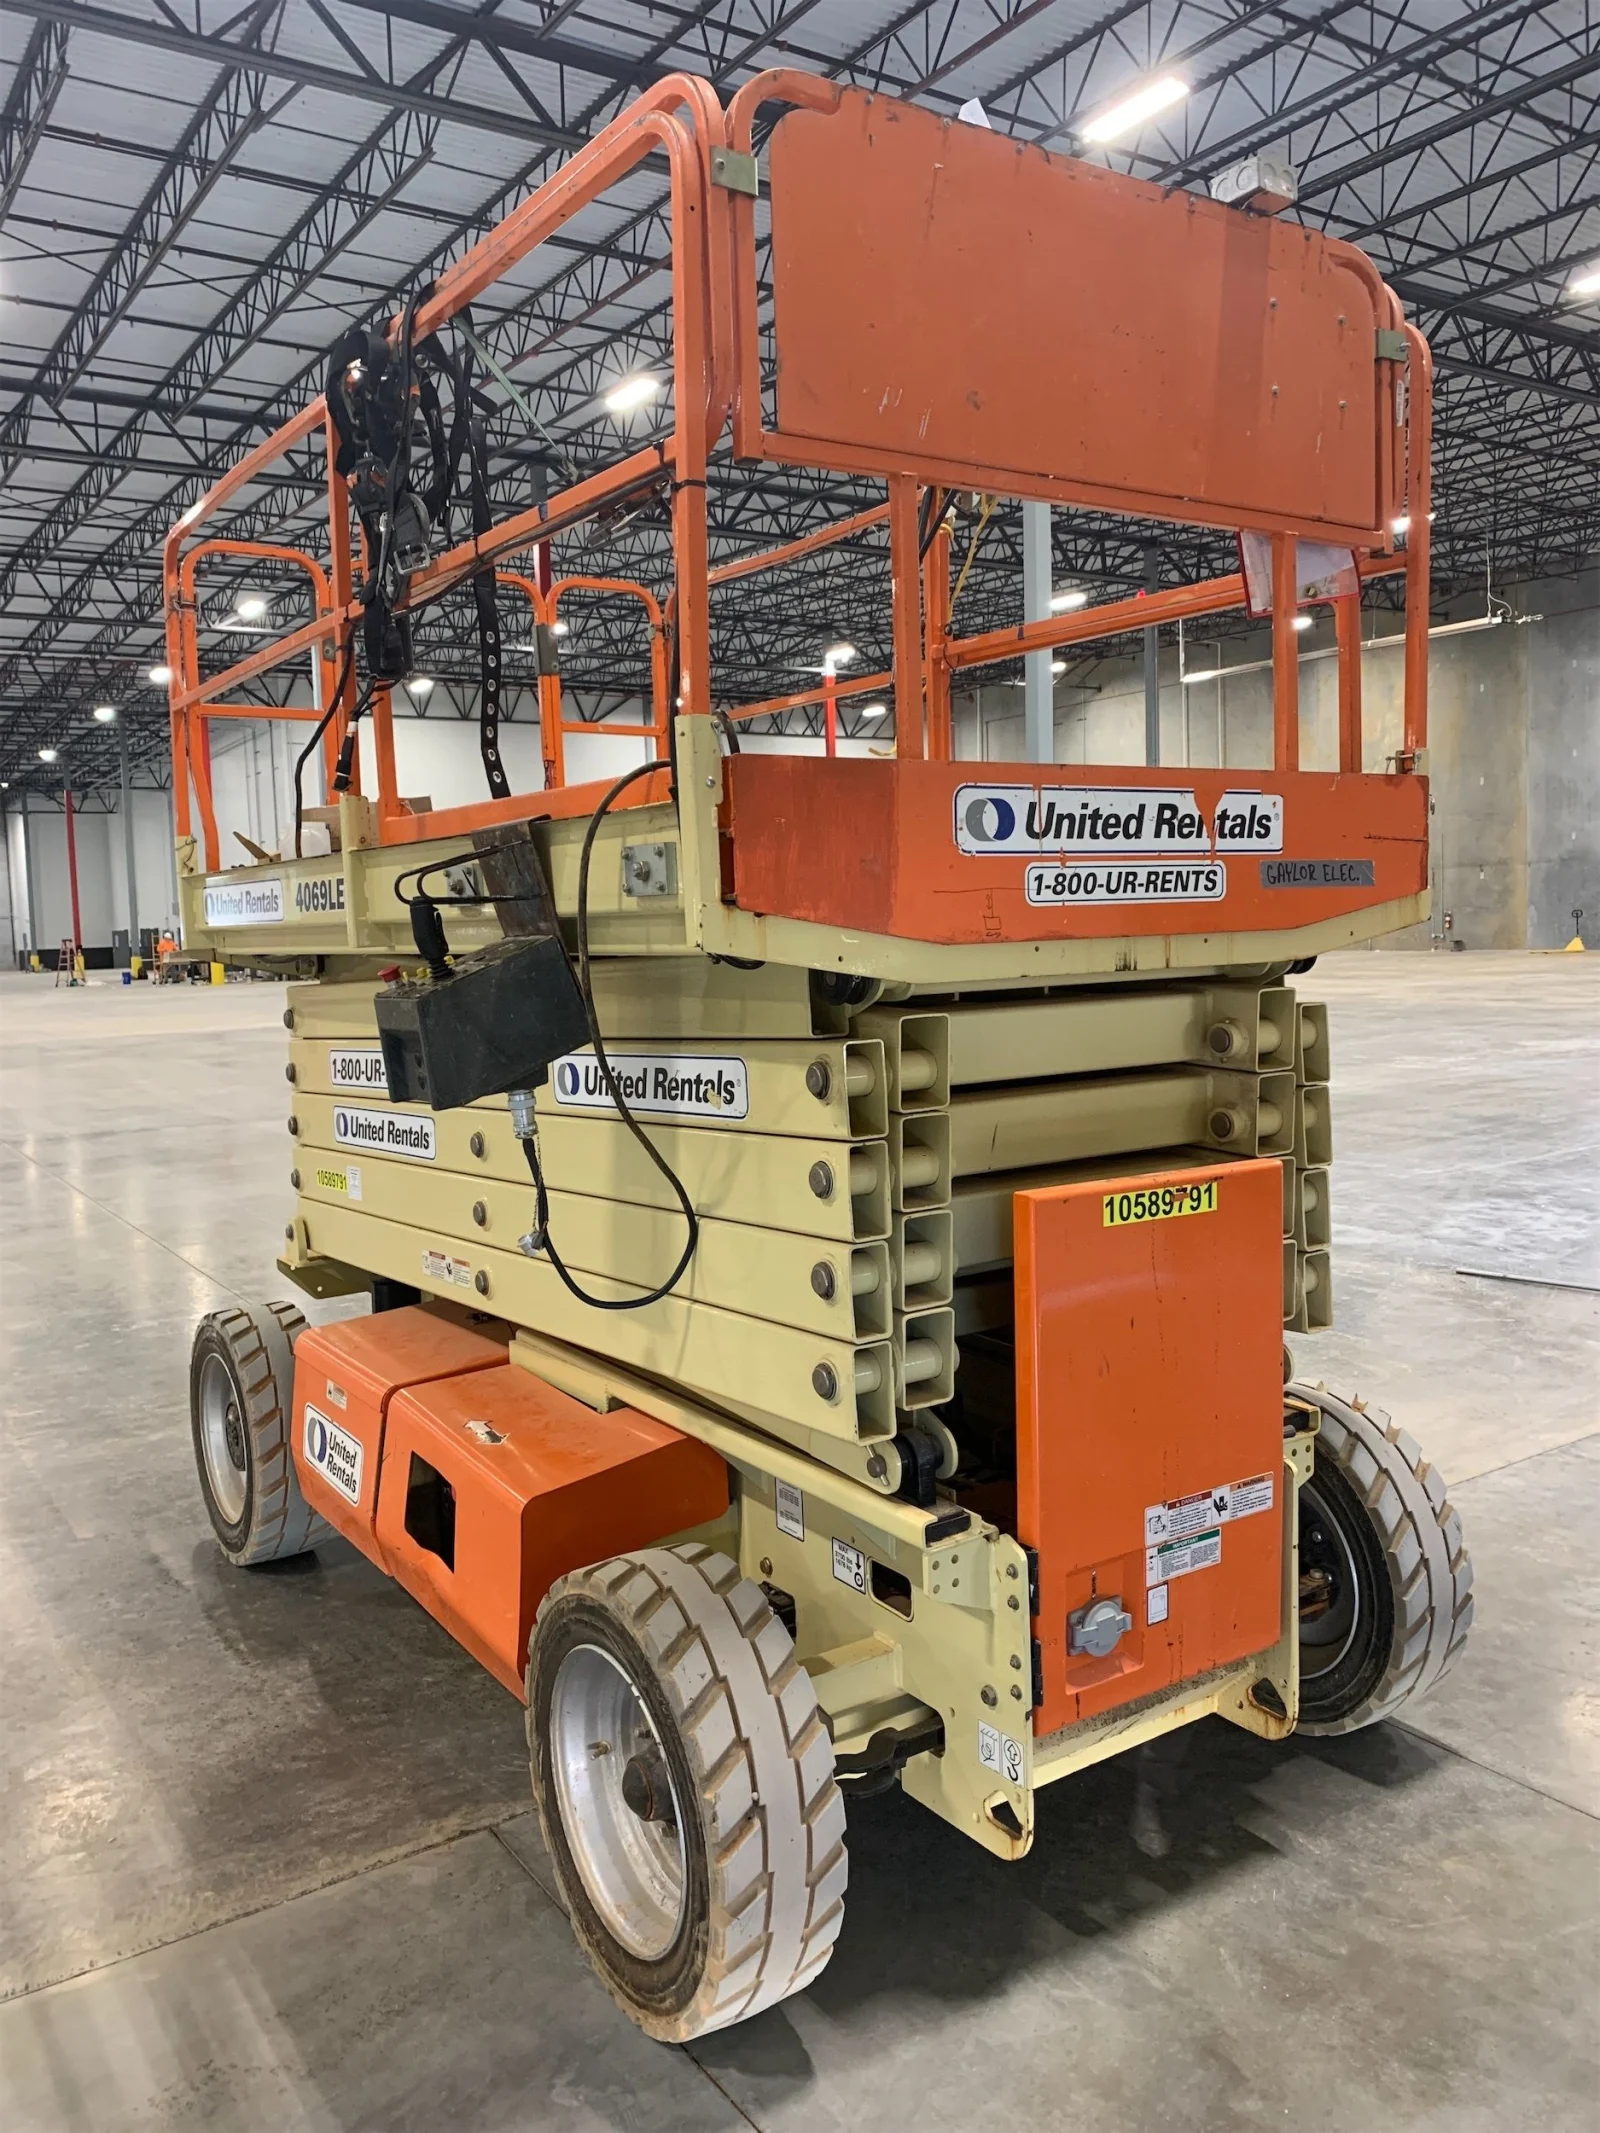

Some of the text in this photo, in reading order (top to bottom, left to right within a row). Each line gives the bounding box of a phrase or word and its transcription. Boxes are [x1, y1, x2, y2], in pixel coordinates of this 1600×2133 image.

[1025, 801, 1146, 840] United
[1033, 869, 1218, 896] 1-800-UR-RENTS
[1266, 862, 1360, 885] GAYLOR ELEC.
[216, 888, 279, 915] United Rentals
[296, 878, 345, 912] 4069LE
[332, 1058, 387, 1082] 1-800-UR-
[653, 1067, 735, 1105] Rentals
[350, 1115, 430, 1150] United Rentals
[317, 1169, 347, 1190] 10589791
[1104, 1183, 1213, 1223] 10589791
[328, 1432, 358, 1469] United
[326, 1454, 358, 1494] Rentals
[1180, 1495, 1203, 1506] DANGER
[1172, 1536, 1199, 1549] IMPORTANT
